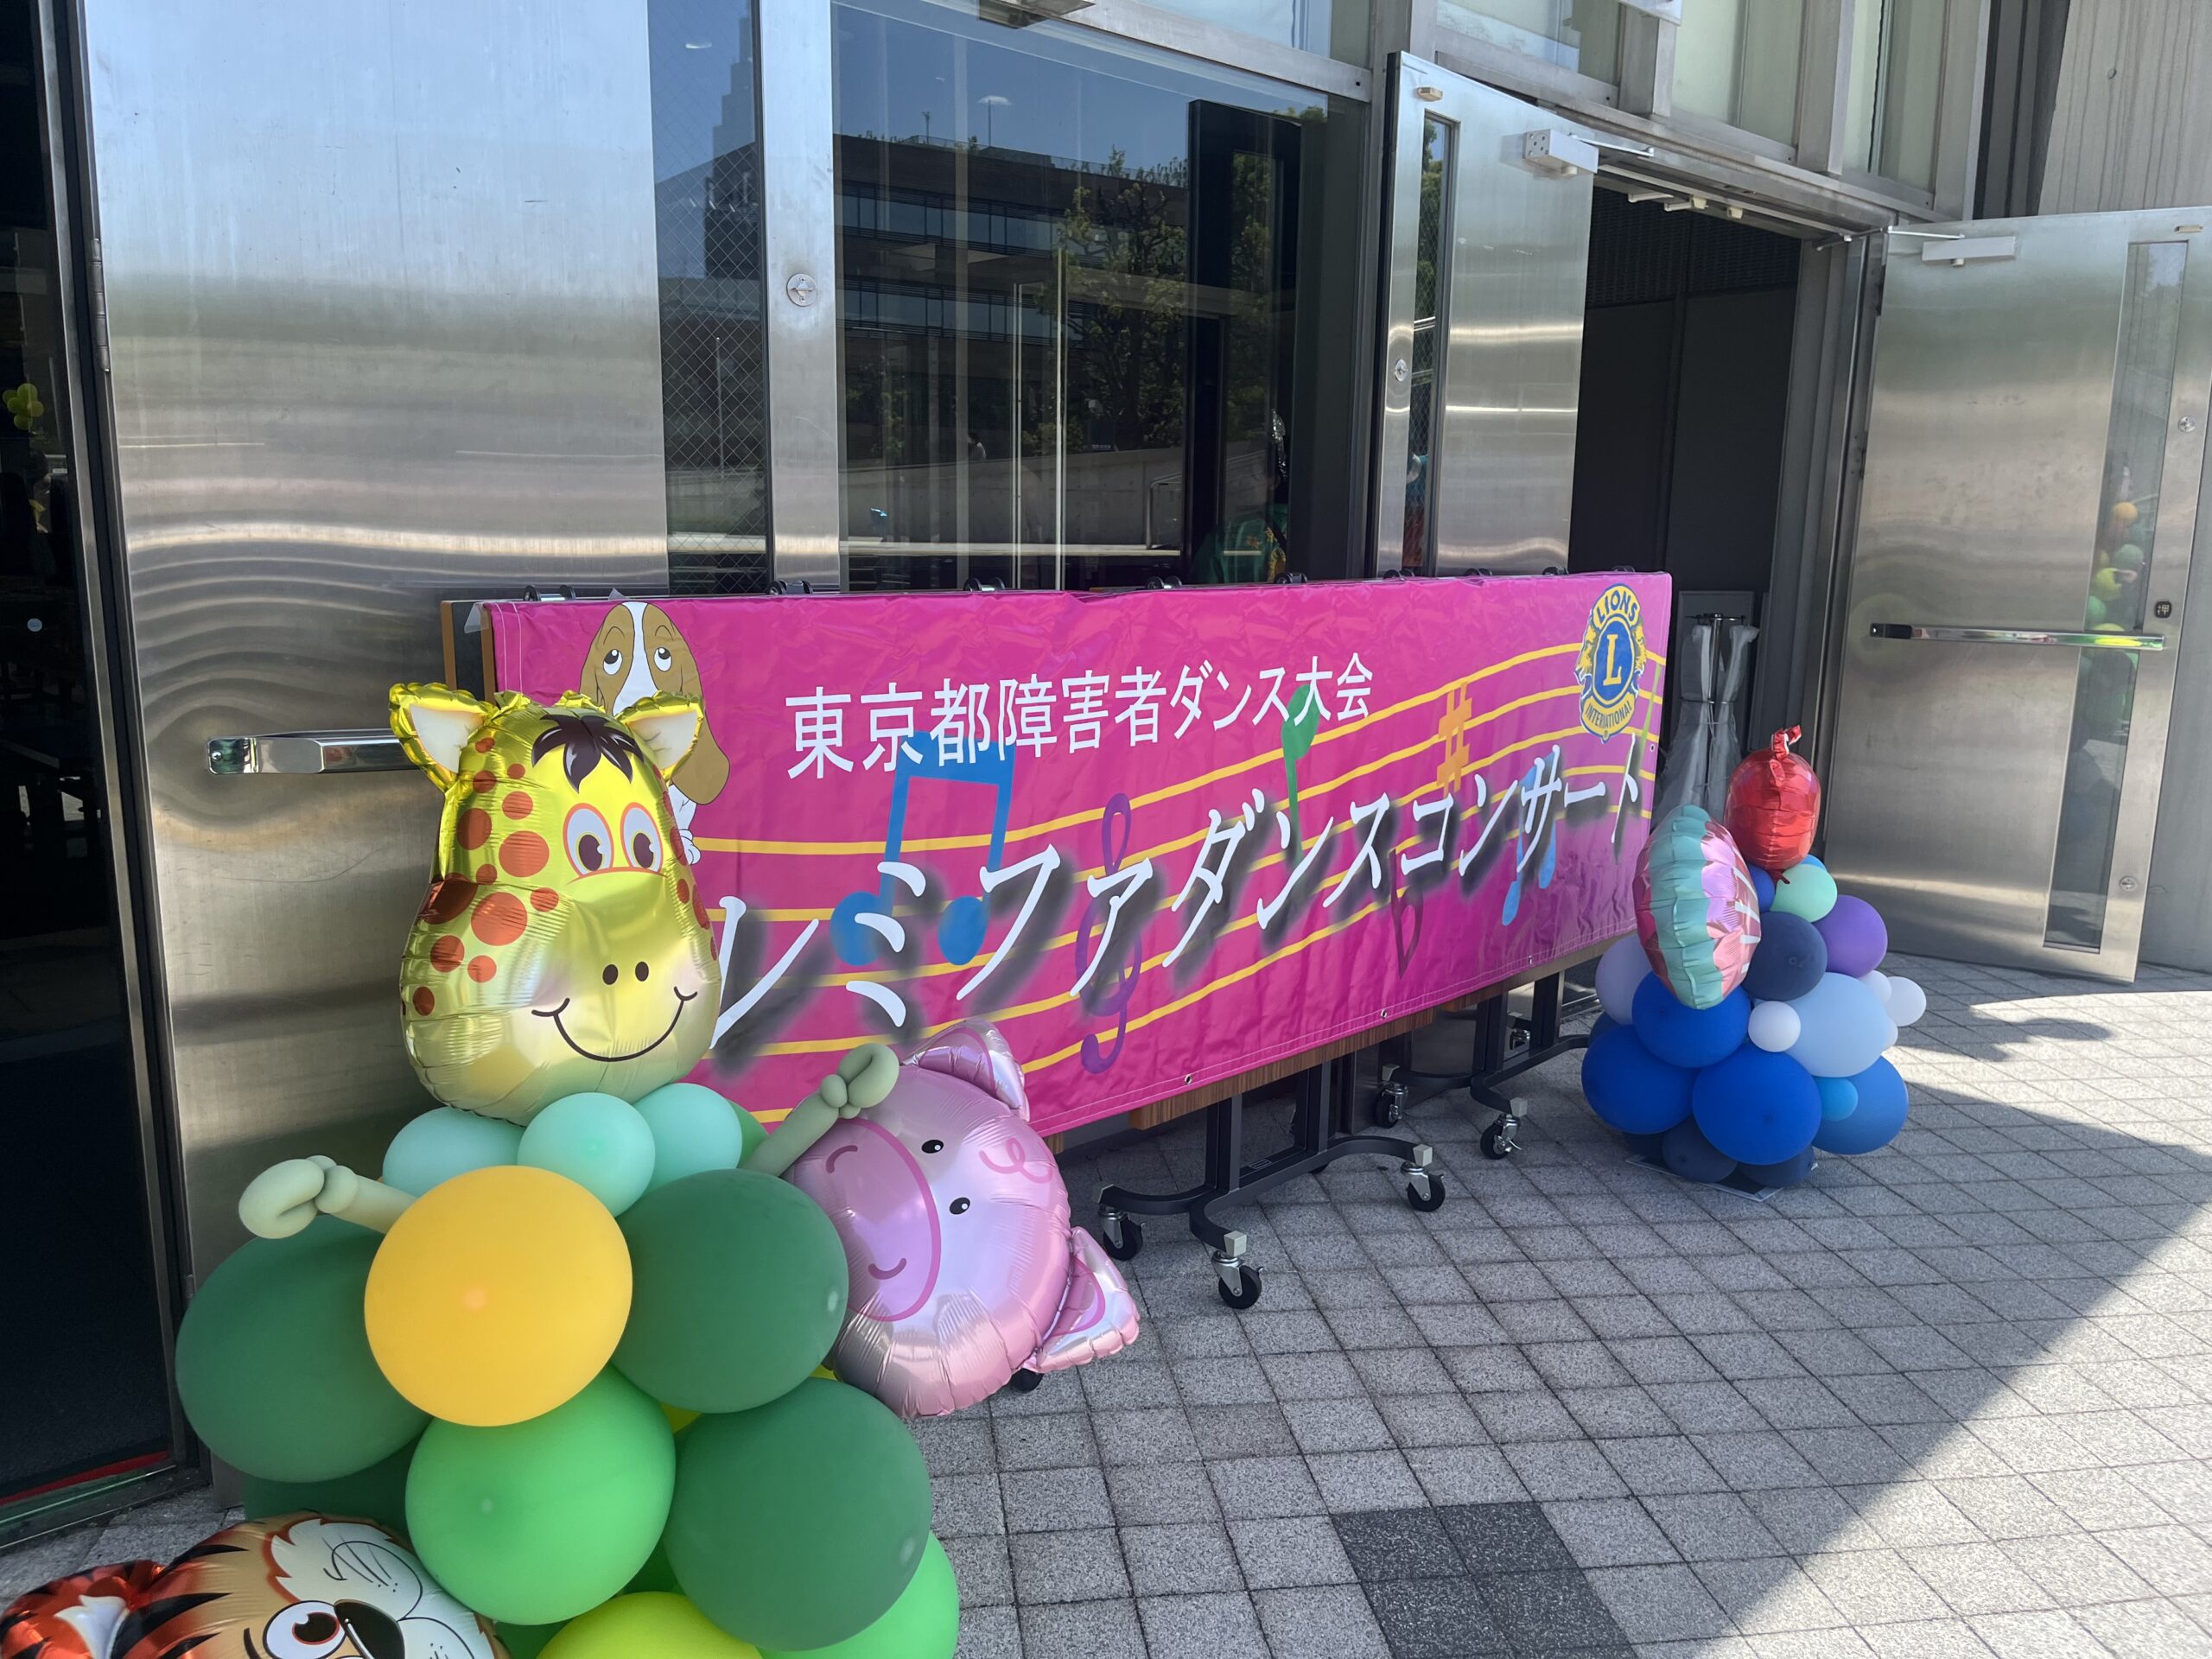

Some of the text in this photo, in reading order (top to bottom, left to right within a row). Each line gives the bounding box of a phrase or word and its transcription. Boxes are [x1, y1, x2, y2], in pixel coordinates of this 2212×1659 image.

[1597, 590, 1637, 623] LIONS
[1603, 633, 1622, 685] L
[785, 652, 1373, 779] 東京都障害者ダンス大会
[709, 733, 1638, 1049] レミファダンスコンサート
